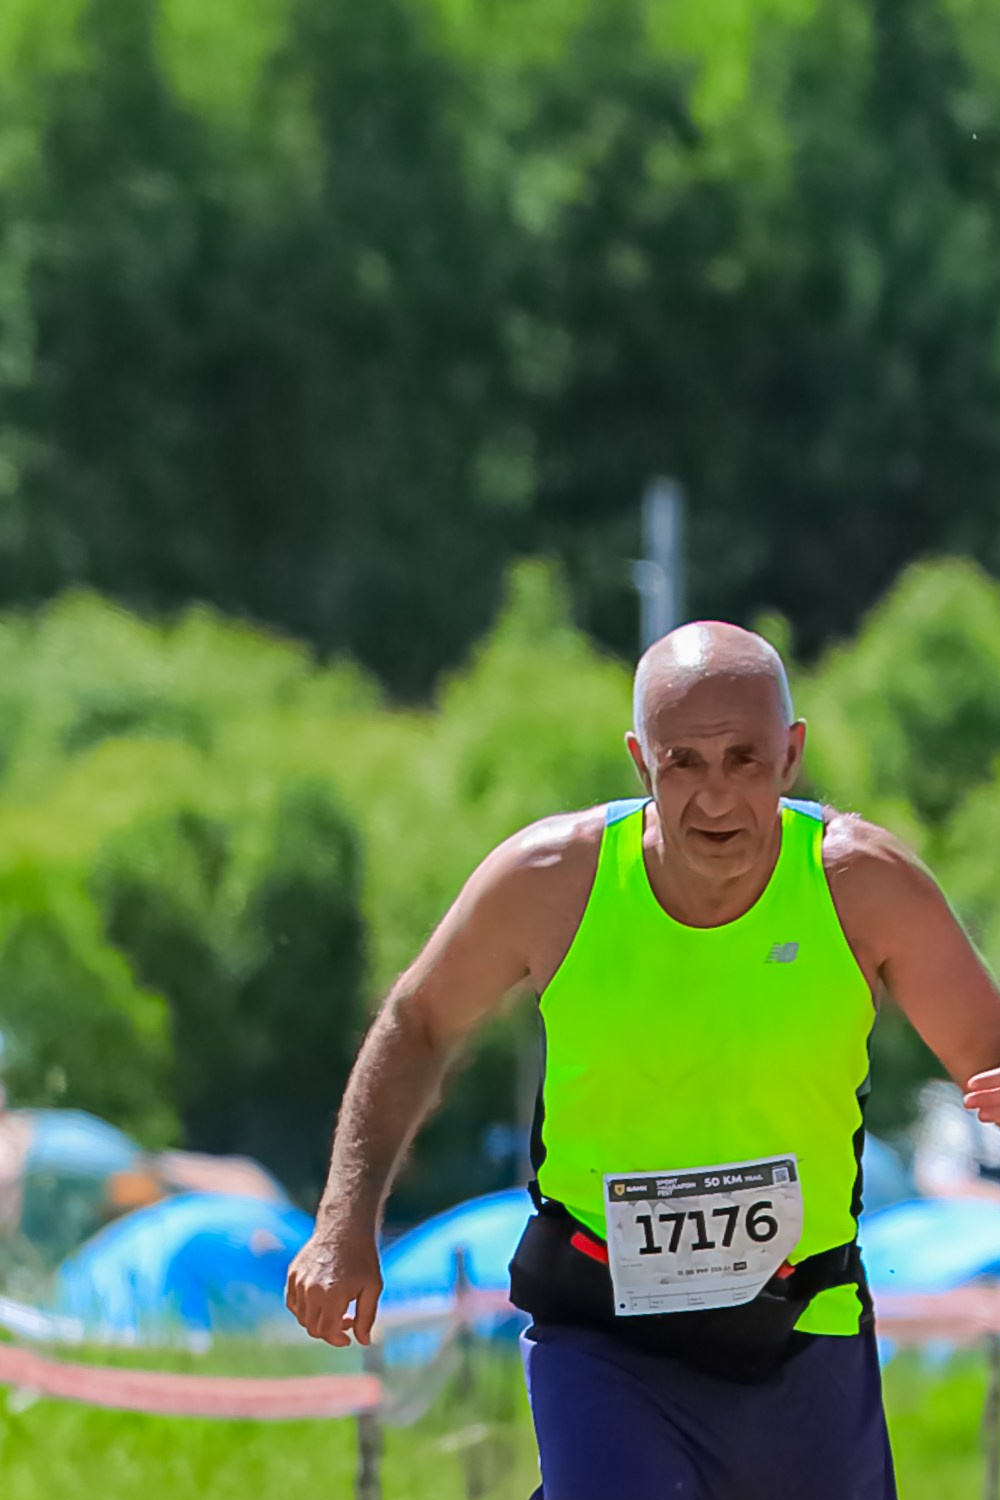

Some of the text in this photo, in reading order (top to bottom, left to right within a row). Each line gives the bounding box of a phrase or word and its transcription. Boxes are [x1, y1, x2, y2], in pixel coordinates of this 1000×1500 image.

[704, 1177, 720, 1188] 50
[723, 1174, 743, 1186] KM
[636, 1201, 778, 1255] 17176
